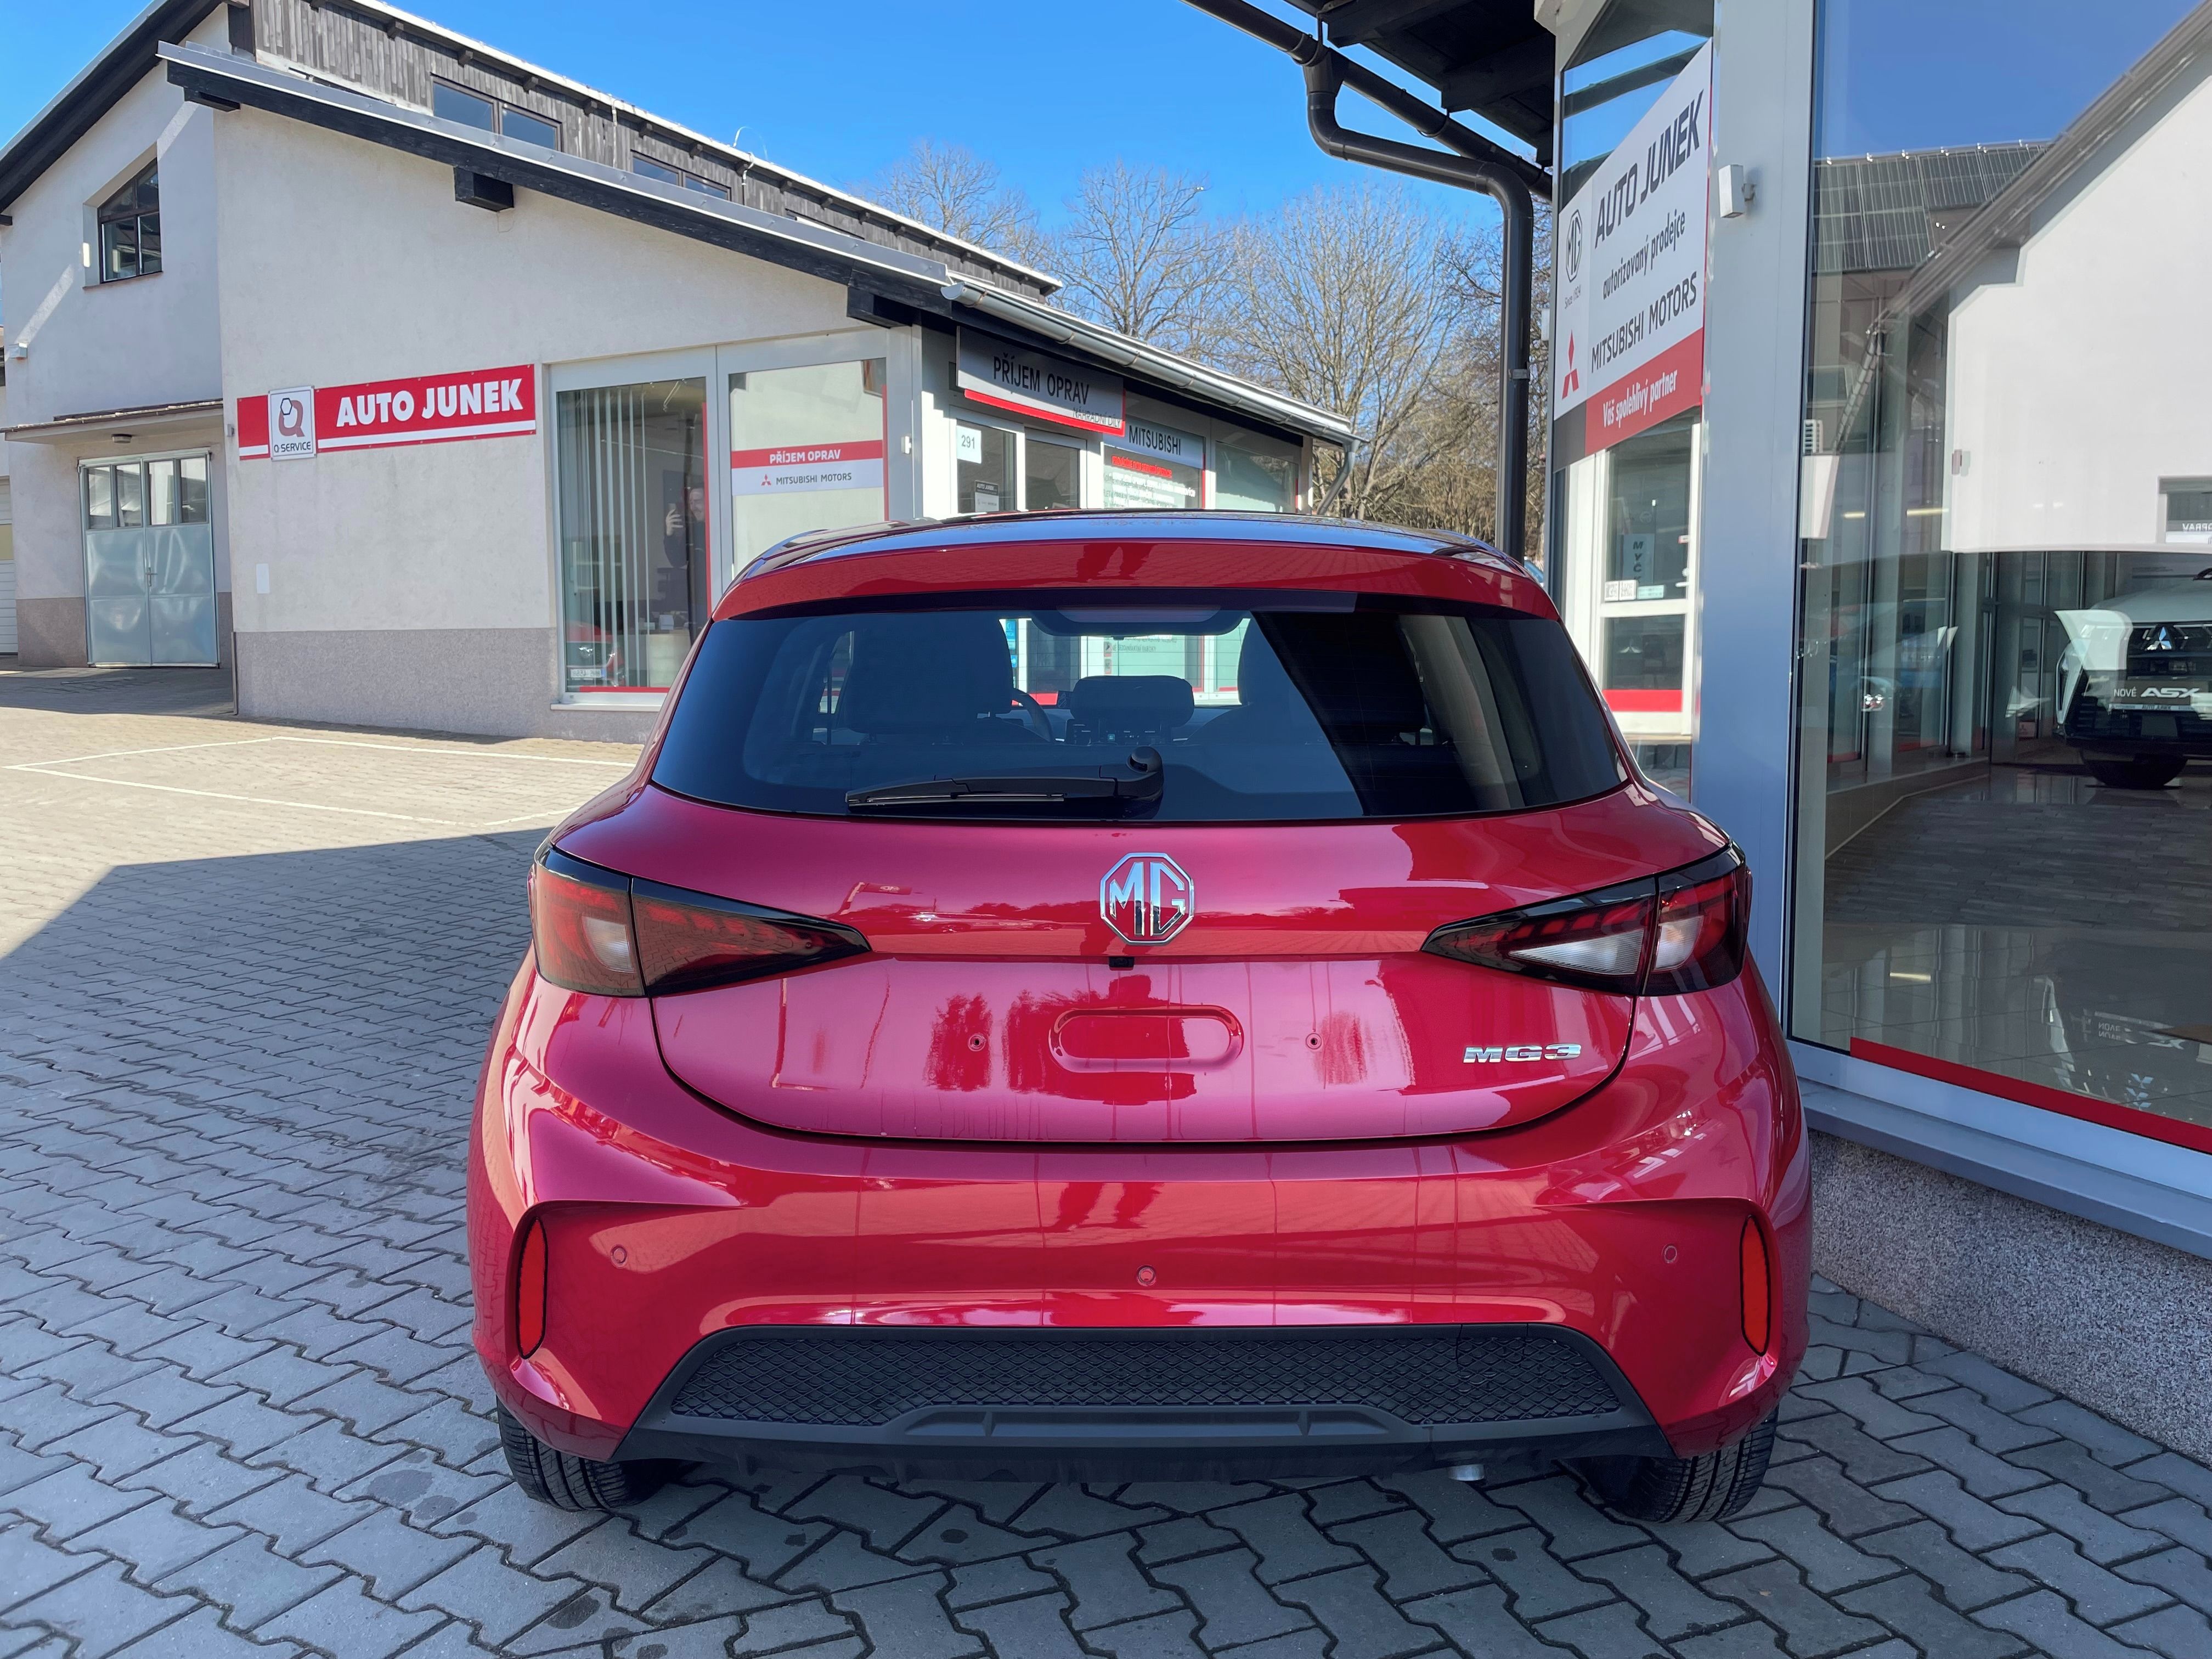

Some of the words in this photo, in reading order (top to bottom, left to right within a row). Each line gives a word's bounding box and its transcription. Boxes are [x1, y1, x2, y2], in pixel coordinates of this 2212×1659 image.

[1595, 163, 1638, 249] AUTO
[1640, 89, 1703, 205] JUNEK
[1567, 215, 1581, 275] MG
[1603, 234, 1649, 300] autorizovaný
[1650, 208, 1685, 270] prodejce
[1592, 310, 1644, 374] MITSUBISHI
[1649, 271, 1697, 334] MOTORS
[994, 352, 1041, 393] PŘÍJEM
[1047, 373, 1090, 405] OPRAV
[1603, 399, 1615, 427] Váš
[1616, 379, 1649, 428] spolehlivý
[1650, 369, 1678, 413] partner
[336, 390, 415, 427] AUTO
[422, 379, 523, 420] JUNEK
[280, 441, 311, 453] SERVICE
[769, 450, 805, 464] PŘÍJEM
[808, 449, 842, 461] OPRAV
[961, 435, 975, 449] 291
[1128, 424, 1181, 456] MITSUBISHI
[776, 475, 817, 486] MITSUBISHI
[821, 472, 852, 483] MOTORS
[2114, 686, 2137, 697] NOVÉ
[2141, 687, 2200, 698] ASX
[1108, 861, 1186, 936] MG
[1463, 1043, 1582, 1063] MG3
